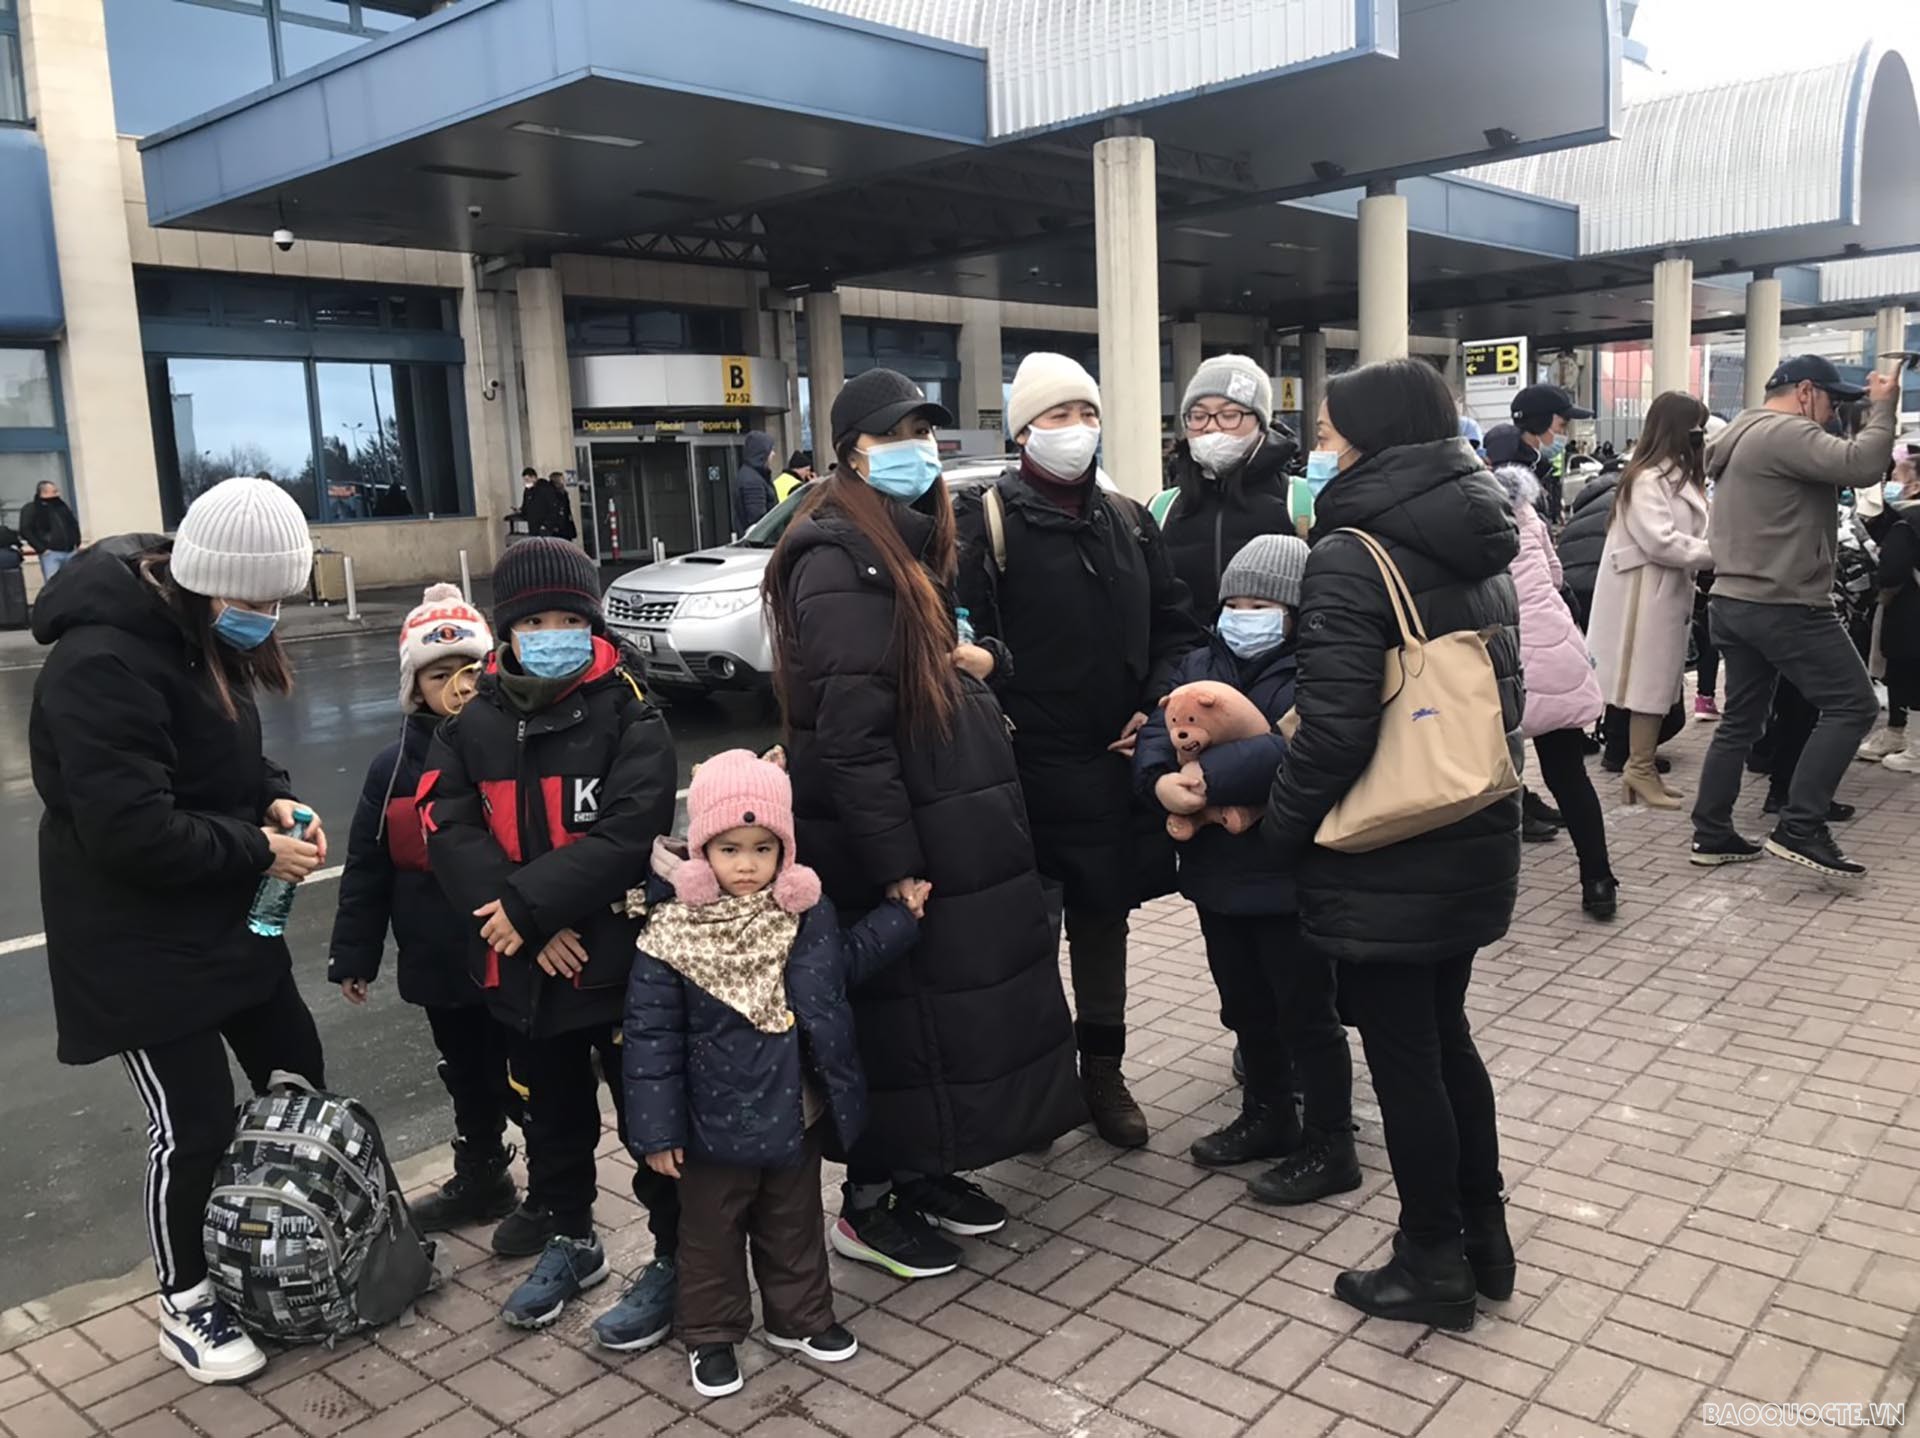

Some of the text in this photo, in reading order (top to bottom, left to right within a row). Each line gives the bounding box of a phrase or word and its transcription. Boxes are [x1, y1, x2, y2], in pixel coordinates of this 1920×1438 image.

[1496, 344, 1519, 372] B
[729, 365, 744, 389] B
[725, 392, 750, 403] 27-52
[1284, 382, 1294, 399] A
[582, 420, 634, 432] Departures
[575, 778, 600, 811] K
